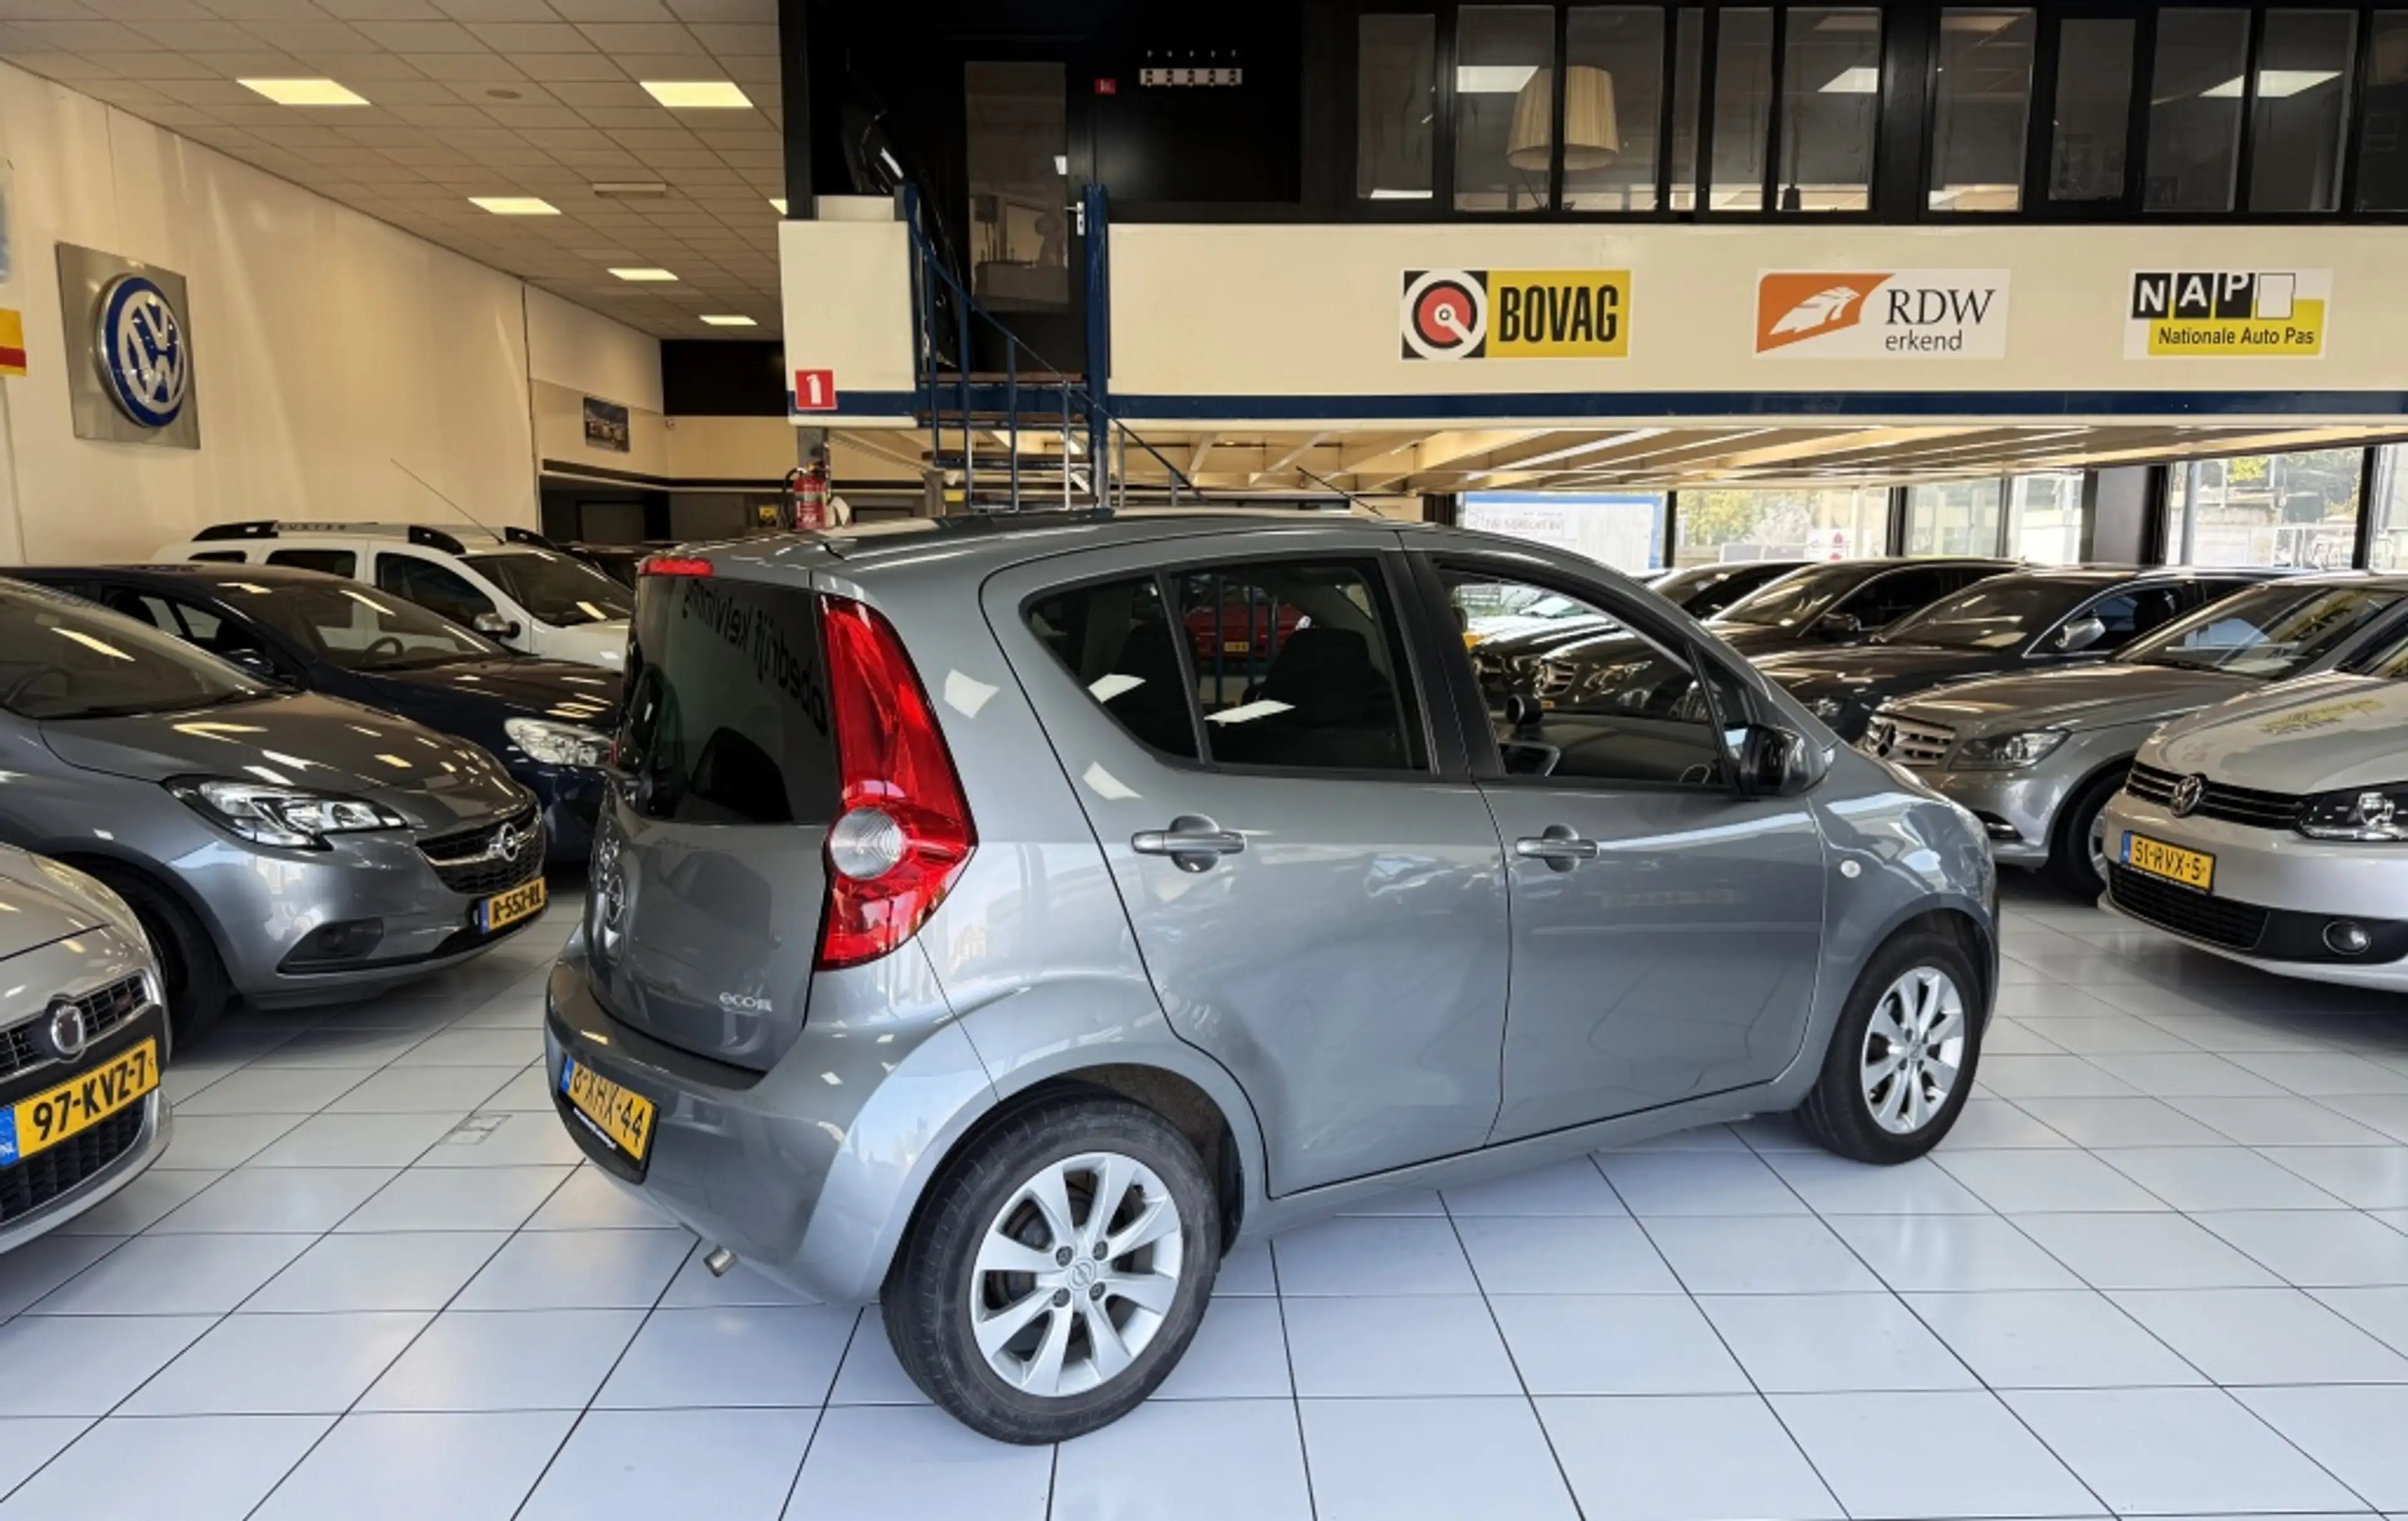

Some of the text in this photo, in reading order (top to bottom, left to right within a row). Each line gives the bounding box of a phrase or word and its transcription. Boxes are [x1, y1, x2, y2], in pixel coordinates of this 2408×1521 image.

[1885, 288, 1997, 325] RDW
[2138, 272, 2250, 312] NAP
[1498, 285, 1619, 344] BOVAG
[1885, 329, 1963, 351] erkend
[2158, 327, 2315, 344] Nationale Auto Pas
[2135, 840, 2201, 880] 51-RVX-5
[33, 1050, 147, 1142] 97-KVZ-7
